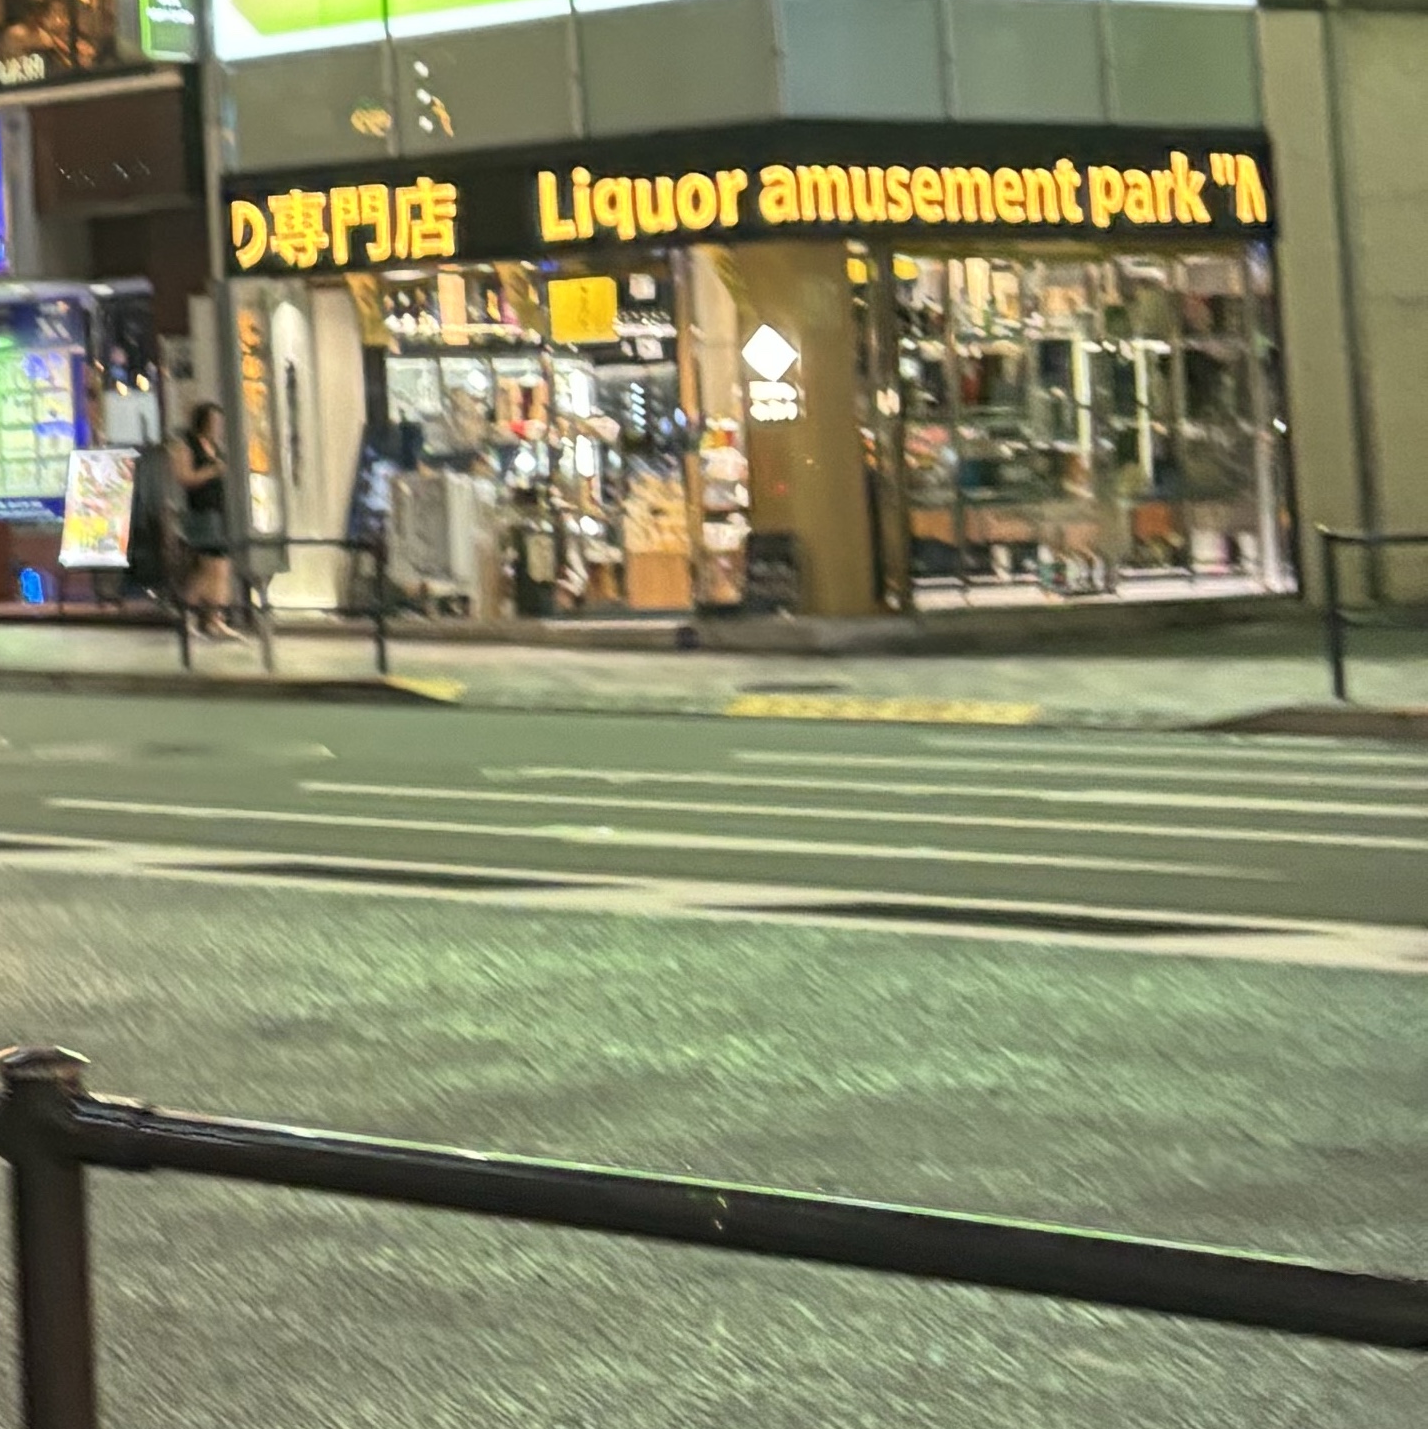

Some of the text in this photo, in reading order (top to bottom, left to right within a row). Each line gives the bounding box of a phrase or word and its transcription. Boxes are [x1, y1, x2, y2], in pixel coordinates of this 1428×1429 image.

[538, 166, 749, 243] Liquor
[758, 157, 1085, 224] amusement
[1087, 150, 1212, 229] park
